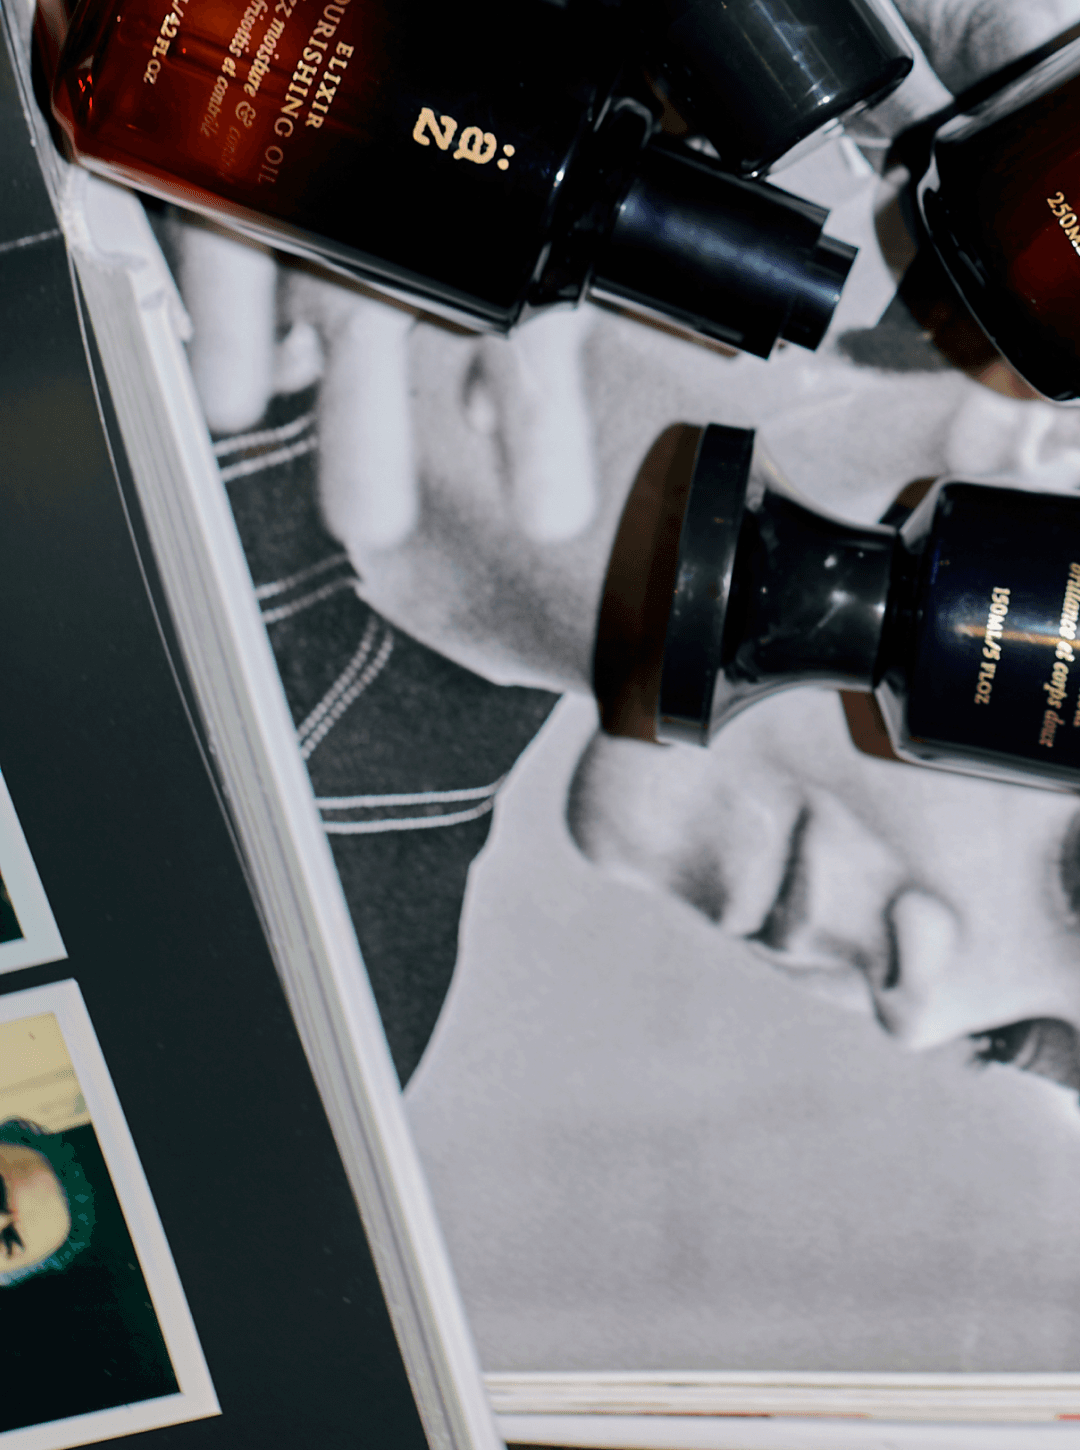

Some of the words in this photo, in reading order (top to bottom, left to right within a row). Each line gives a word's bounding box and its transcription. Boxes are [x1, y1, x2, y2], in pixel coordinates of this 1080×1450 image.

[221, 56, 237, 78] et
[243, 17, 286, 98] moisture
[200, 74, 229, 137] contrôle
[305, 41, 355, 129] ELIXIR
[234, 100, 257, 128] &
[257, 145, 284, 183] OIL
[981, 586, 1011, 661] 150ML/5
[1054, 637, 1079, 663] et
[1042, 661, 1070, 709] corps
